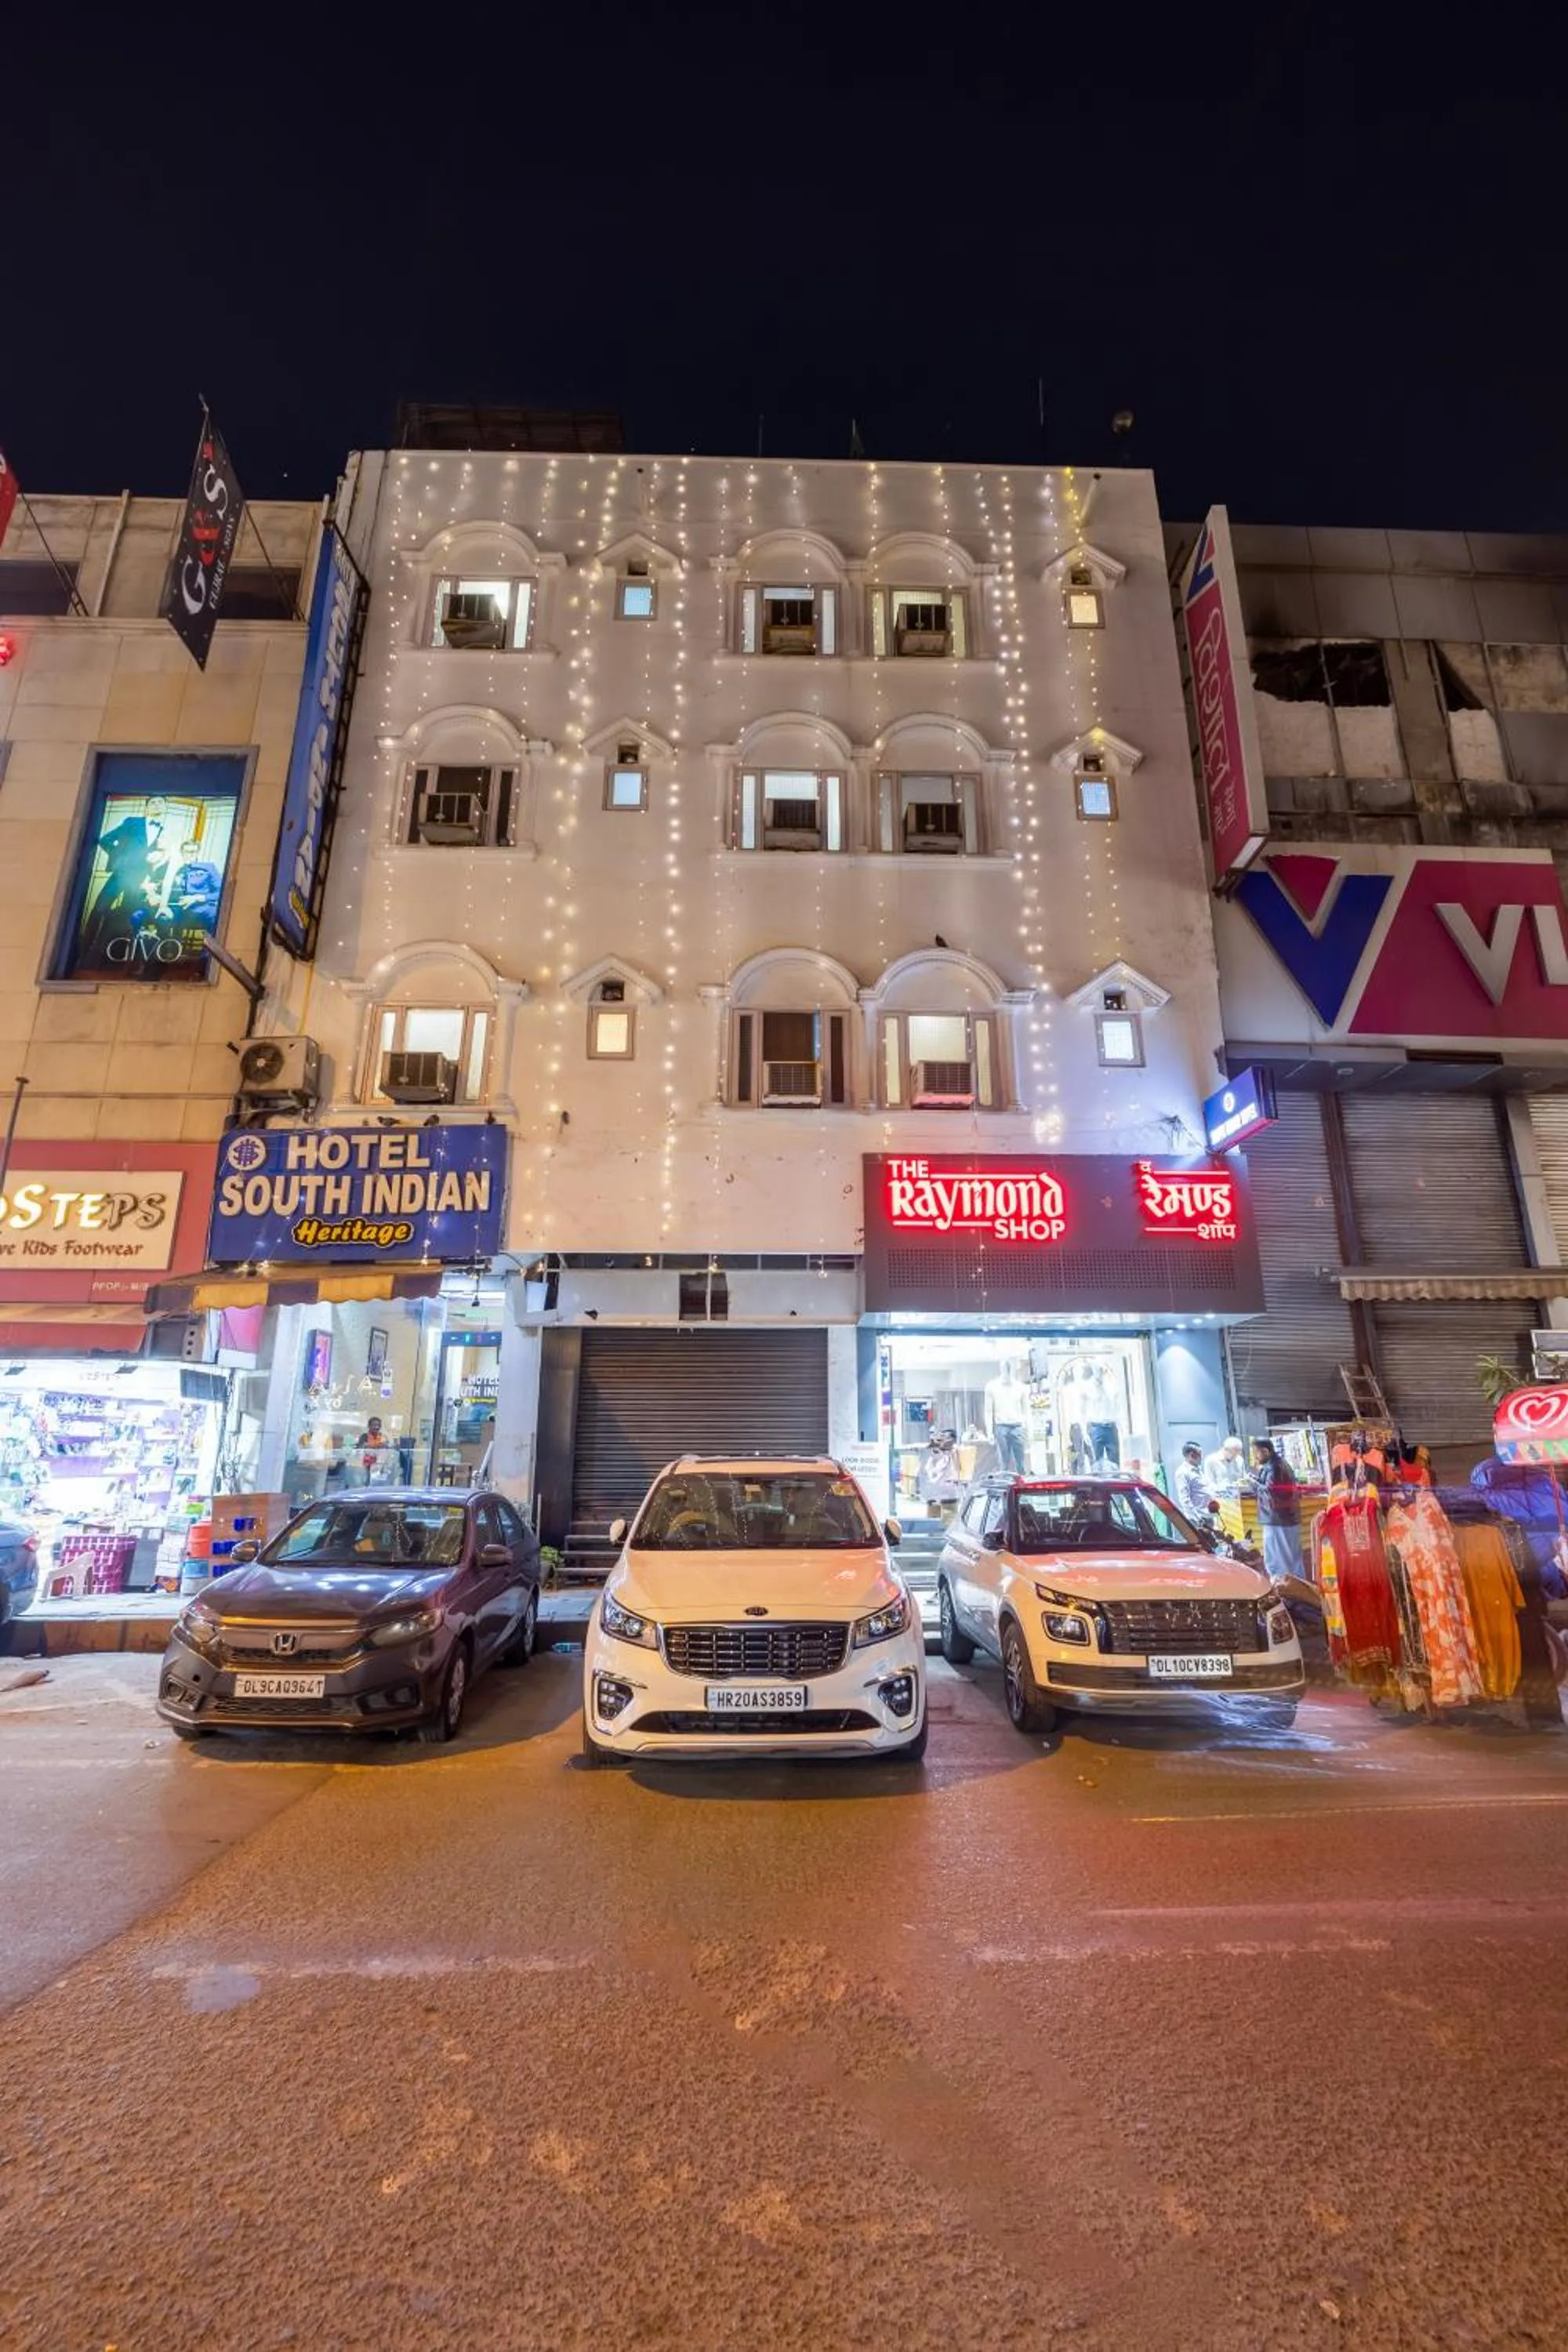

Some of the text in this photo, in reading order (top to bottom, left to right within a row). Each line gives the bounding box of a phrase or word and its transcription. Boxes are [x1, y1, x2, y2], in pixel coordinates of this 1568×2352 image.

[107, 936, 183, 963] GIVO
[286, 1134, 430, 1171] HOTEL
[887, 1160, 929, 1178] THE
[0, 1183, 165, 1230] STEPS
[219, 1171, 492, 1216] SOUTH INDIAN
[887, 1172, 1065, 1230] Raymond
[295, 1218, 409, 1246] Heritage
[993, 1219, 1065, 1240] SHOP
[1196, 1219, 1237, 1240] शॉप
[23, 1240, 58, 1255] Kids
[64, 1240, 144, 1256] Footwear
[717, 1691, 803, 1708] HR20AS3859
